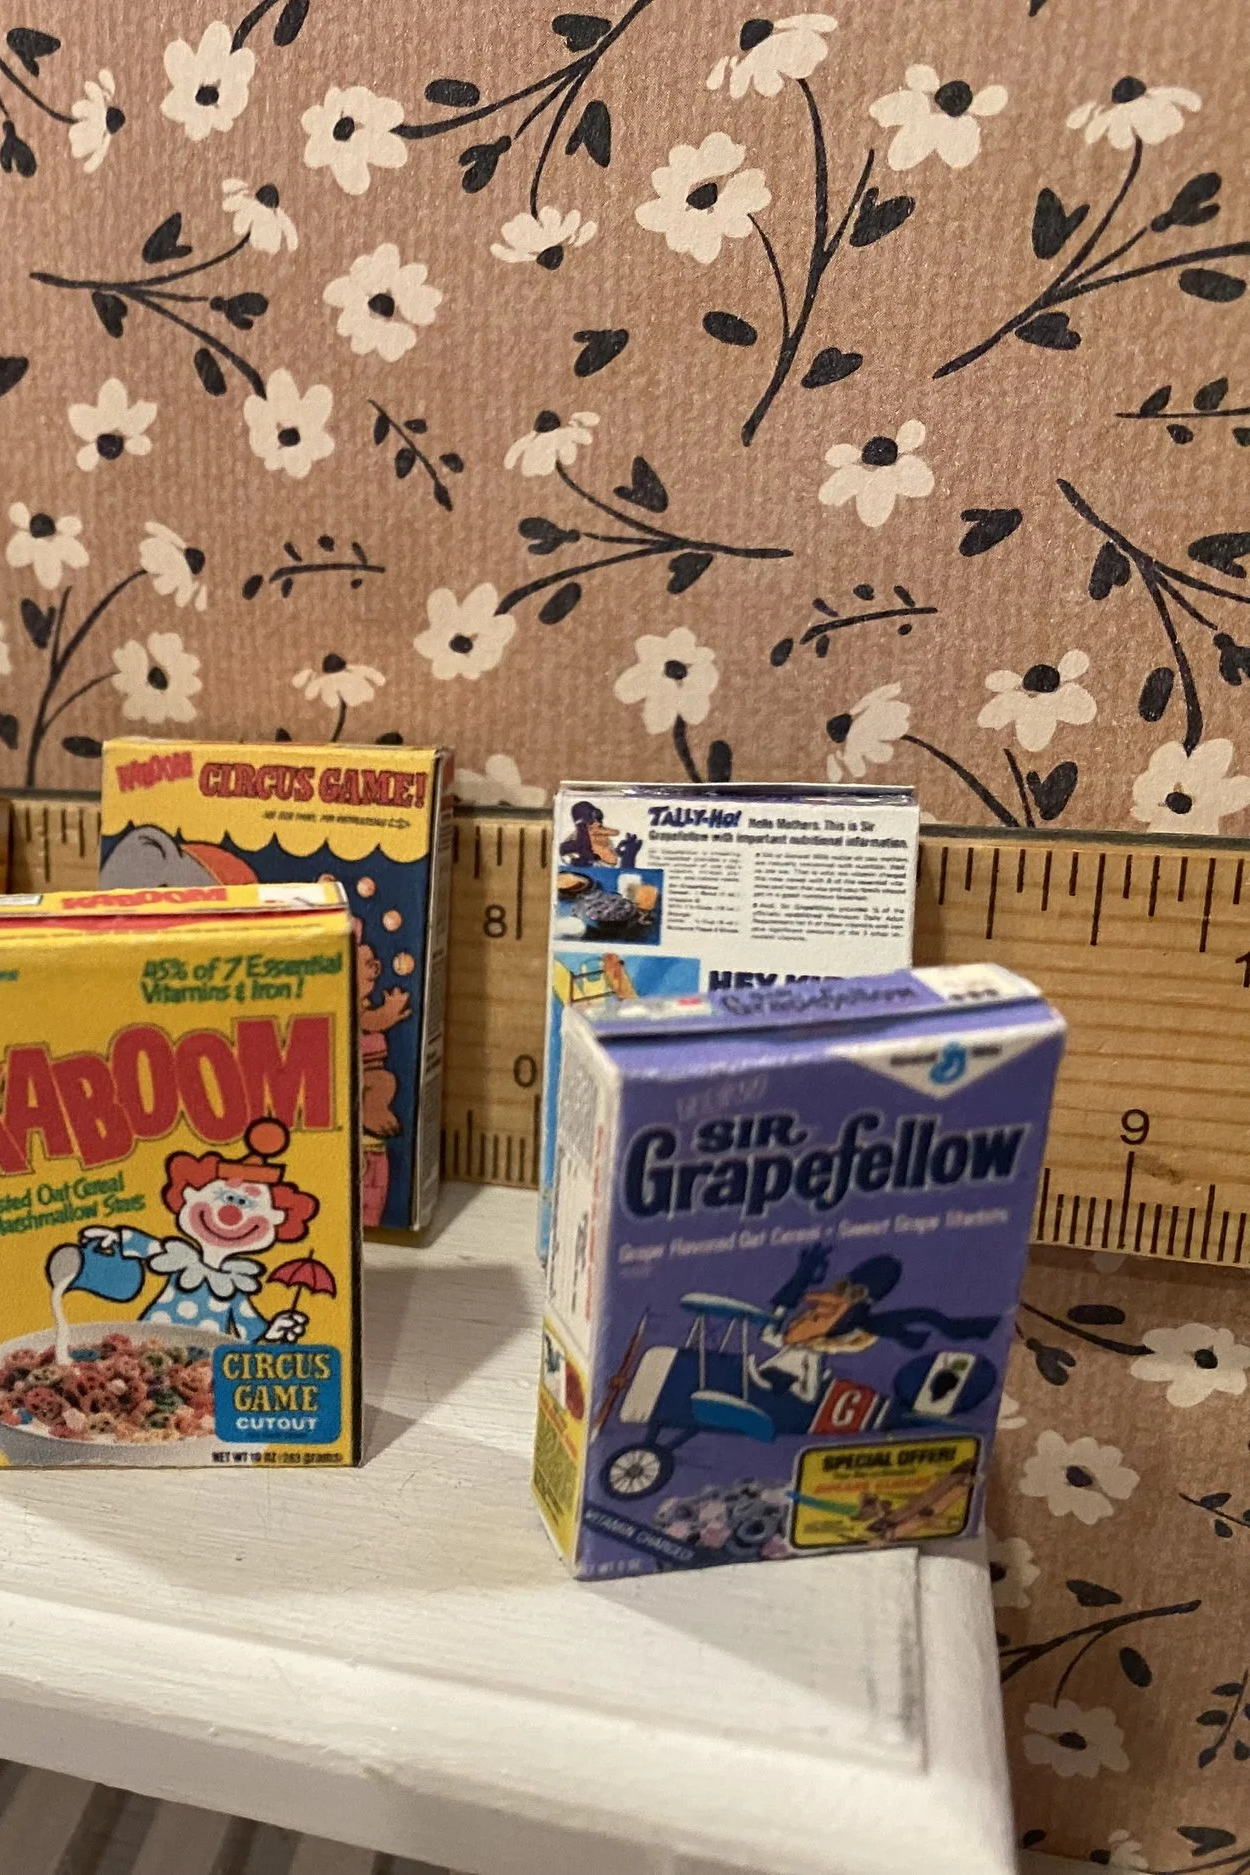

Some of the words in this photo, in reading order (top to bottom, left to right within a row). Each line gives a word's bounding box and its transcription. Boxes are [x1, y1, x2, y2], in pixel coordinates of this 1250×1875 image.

[199, 762, 316, 802] CIRCUS
[319, 767, 428, 809] GAME!
[482, 904, 508, 938] 8
[192, 956, 220, 981] of
[223, 954, 244, 982] 7
[245, 951, 343, 978] Essential
[694, 1108, 812, 1157] SIR
[623, 1110, 1031, 1222] Grapefellow
[36, 1181, 71, 1205] Oat
[72, 1170, 126, 1201] Cereal
[222, 1352, 331, 1380] CIRCUS
[233, 1383, 319, 1413] GAME
[235, 1416, 318, 1430] CUTOUT
